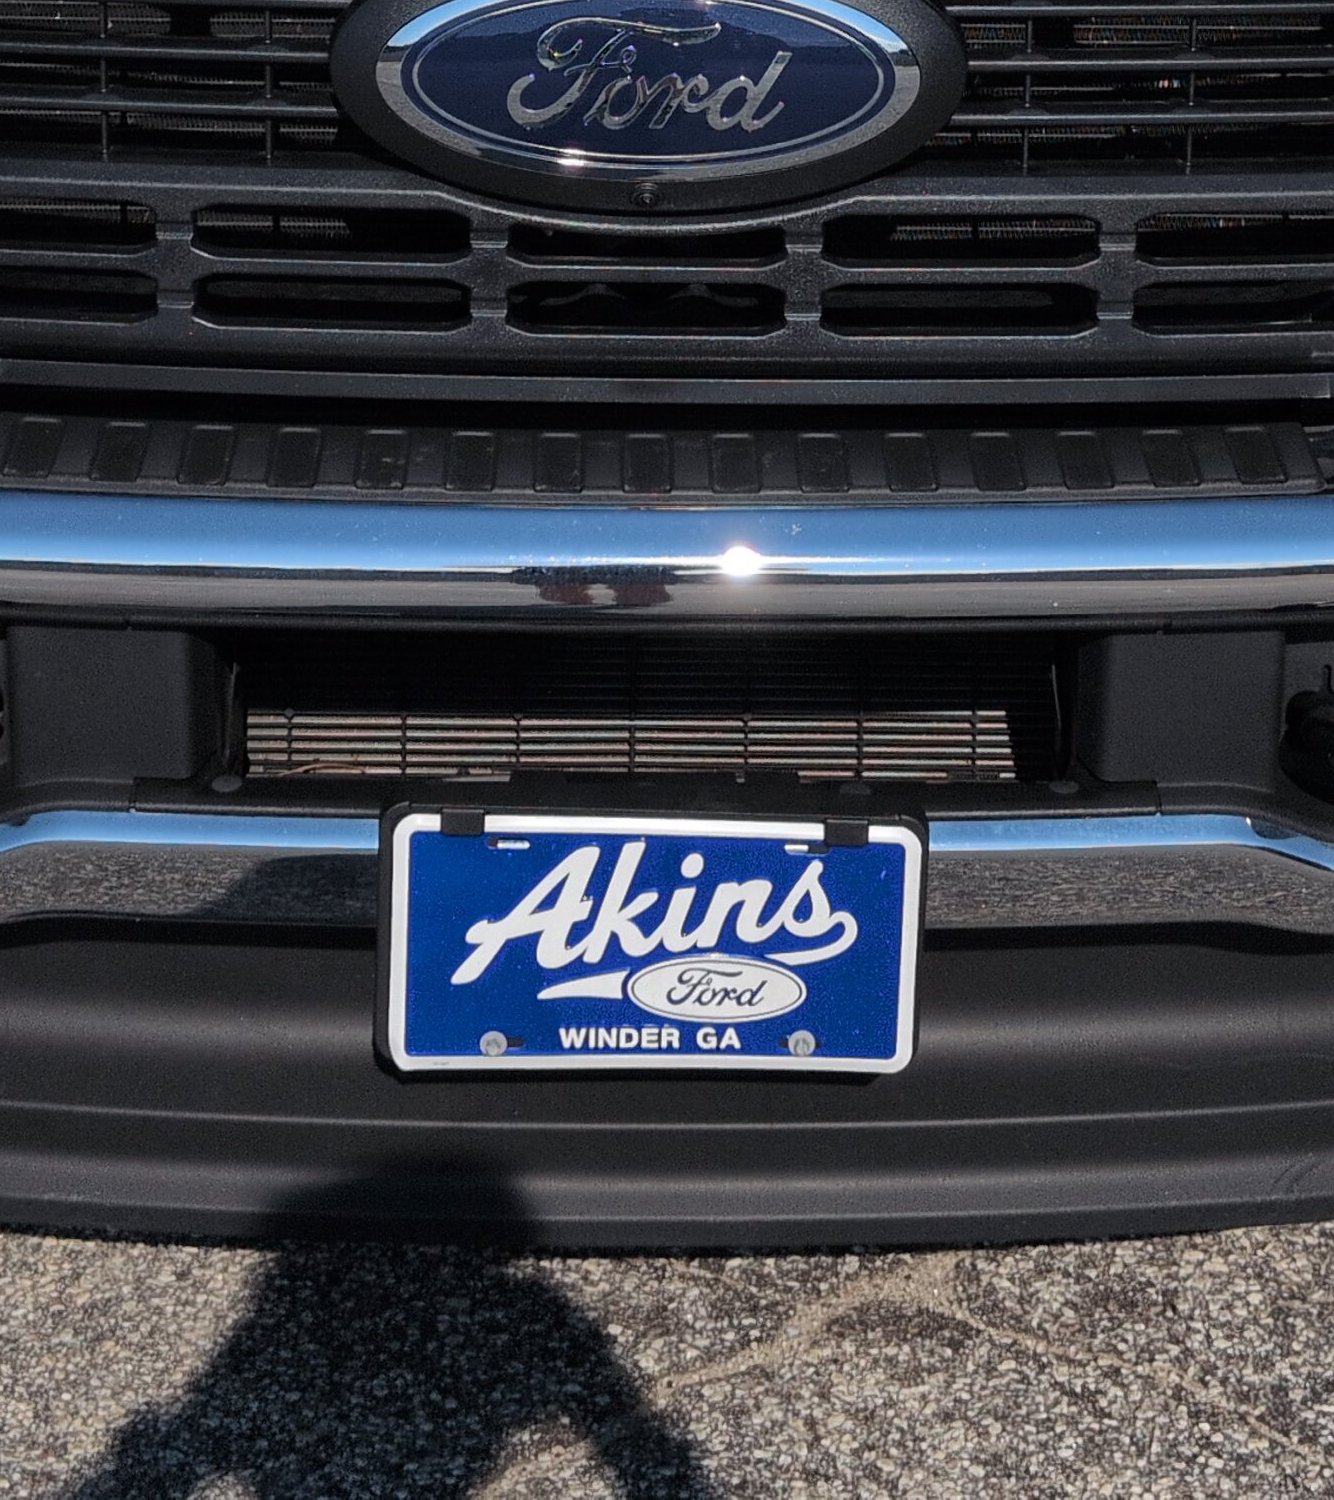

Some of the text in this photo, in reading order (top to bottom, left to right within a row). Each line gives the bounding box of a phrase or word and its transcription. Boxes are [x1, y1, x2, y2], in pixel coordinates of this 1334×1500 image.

[505, 15, 793, 131] Ford
[450, 840, 858, 985] Akins
[665, 967, 769, 1010] Ford
[558, 1026, 741, 1050] WINDER GA
